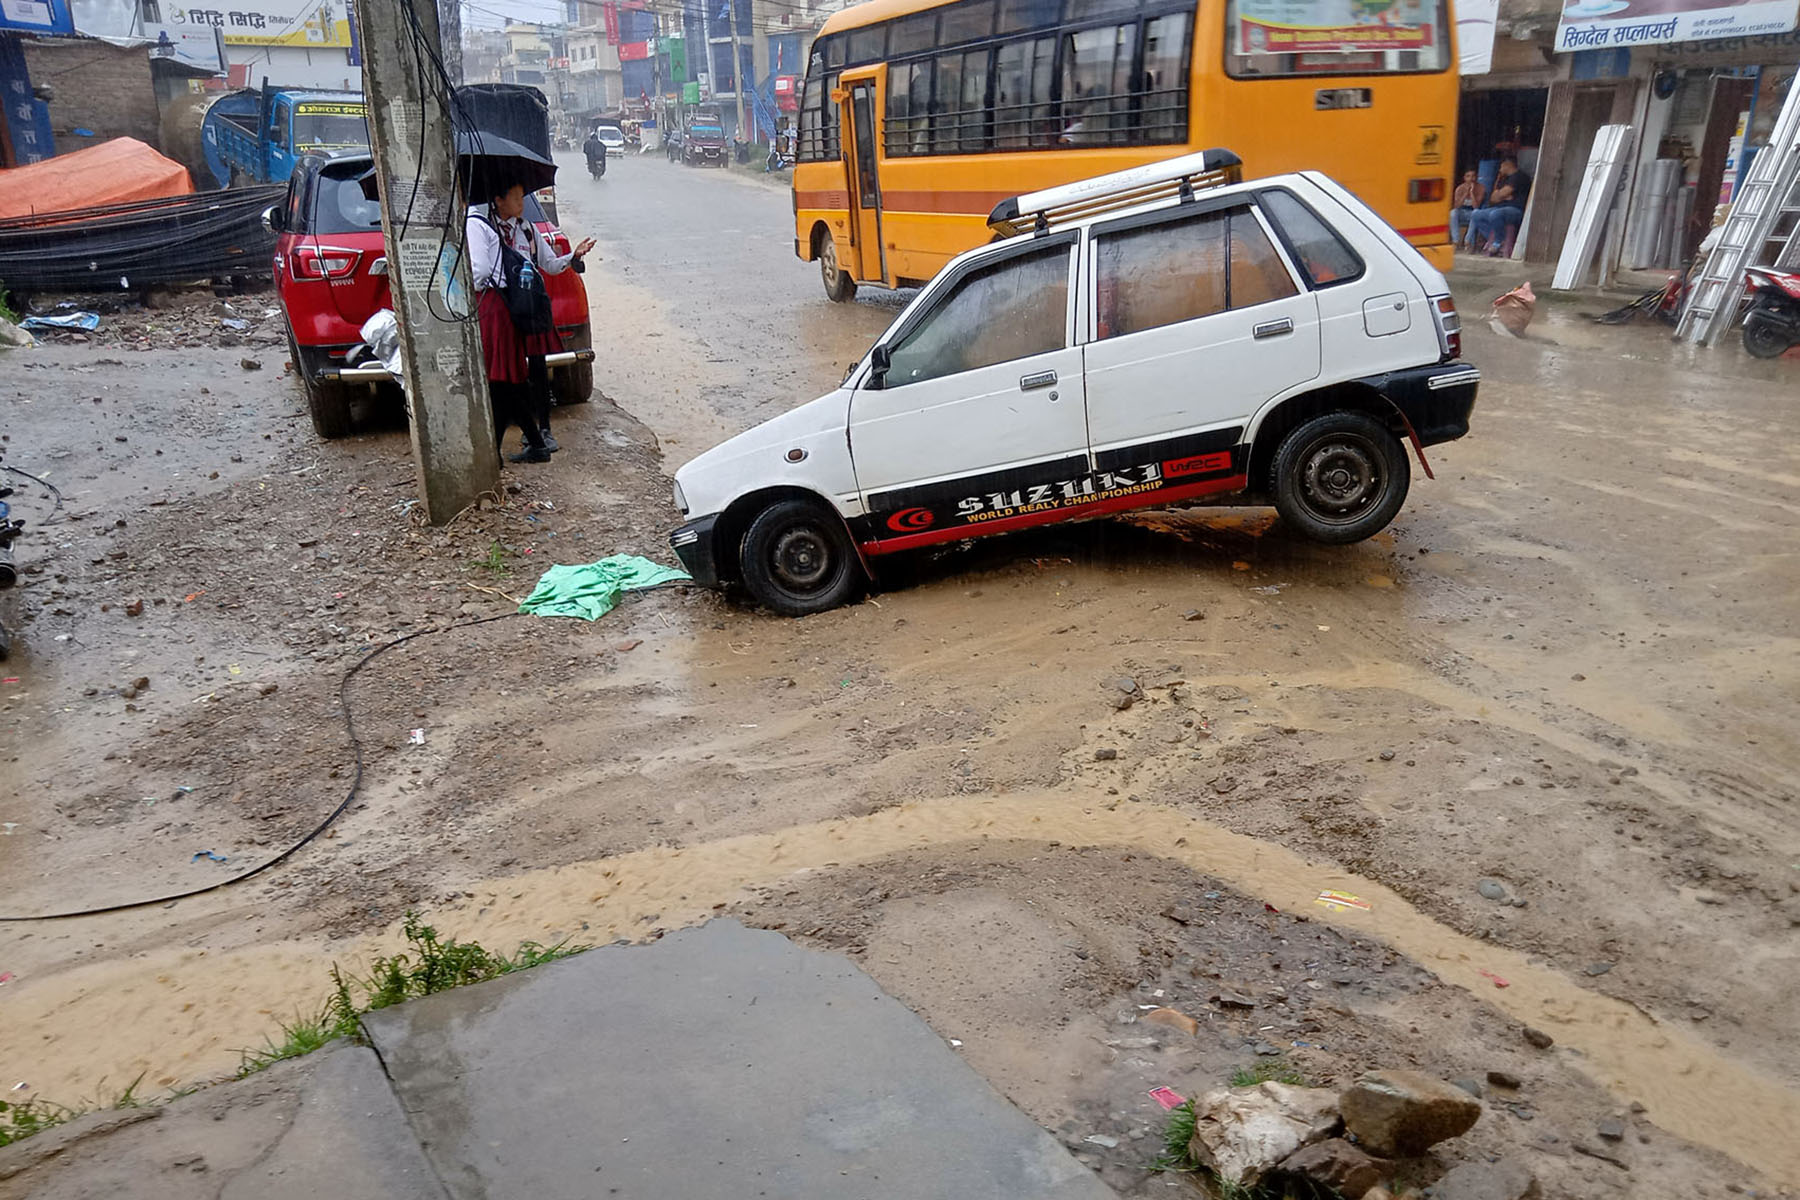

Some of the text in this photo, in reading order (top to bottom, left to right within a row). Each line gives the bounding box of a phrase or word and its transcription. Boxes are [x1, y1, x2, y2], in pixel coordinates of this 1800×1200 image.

[188, 9, 225, 27] रिद्धि
[228, 11, 266, 29] सिद्धि
[1562, 17, 1679, 48] सिग्देल सप्लायर्स
[1169, 457, 1222, 473] WRC
[967, 480, 1163, 523] WORLD REALY CHAMPIONSHIP
